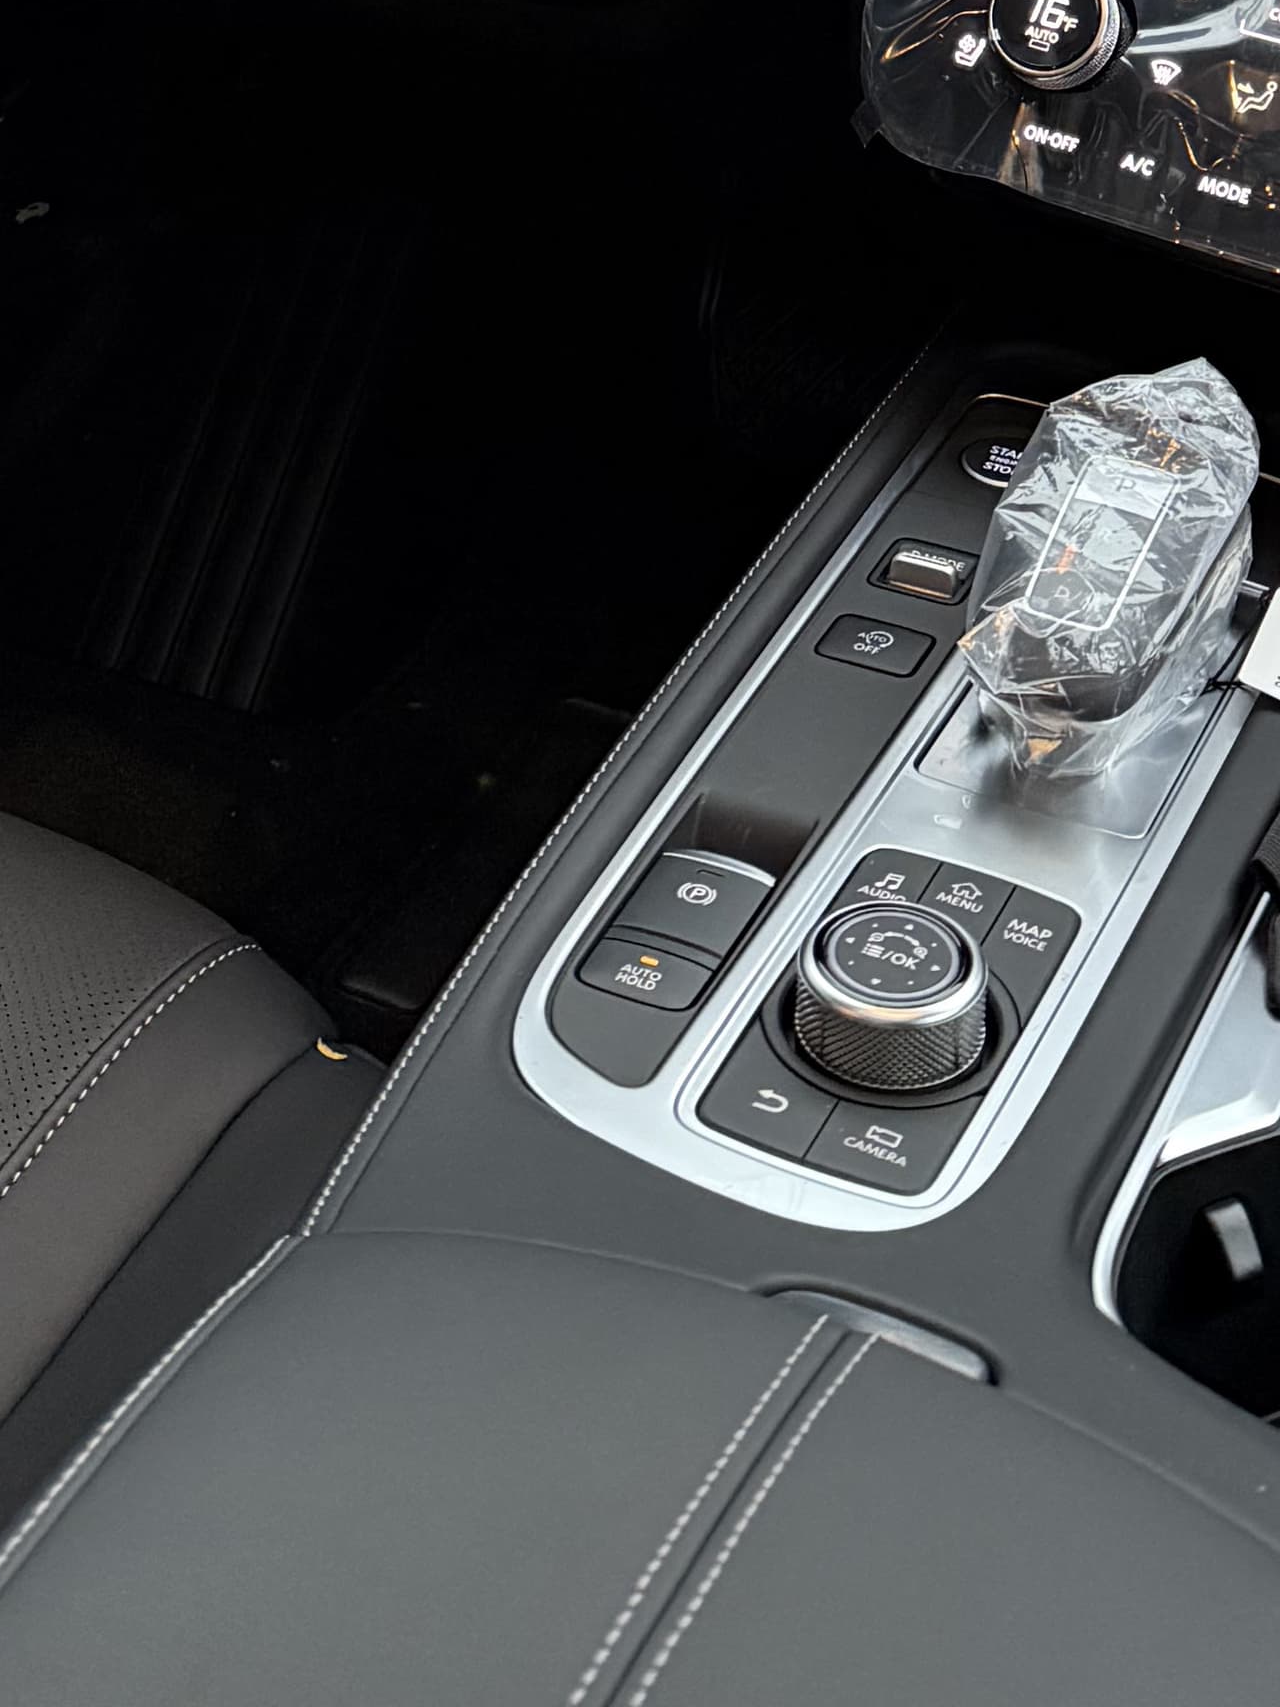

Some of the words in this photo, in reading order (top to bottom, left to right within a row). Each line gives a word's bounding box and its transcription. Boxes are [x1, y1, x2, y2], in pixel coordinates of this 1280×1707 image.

[1024, 25, 1061, 45] AUTO
[1119, 152, 1156, 177] A/C
[1197, 176, 1253, 205] MODE
[988, 444, 1023, 460] STA
[982, 461, 1015, 475] STO
[853, 642, 881, 655] OFF
[857, 881, 908, 904] AUDIO
[935, 889, 985, 915] MENU
[1003, 928, 1048, 953] VOICE
[1006, 918, 1054, 942] MAP
[613, 969, 658, 992] HOLD
[618, 961, 664, 984] AUTO
[842, 1136, 910, 1169] CAMERA
